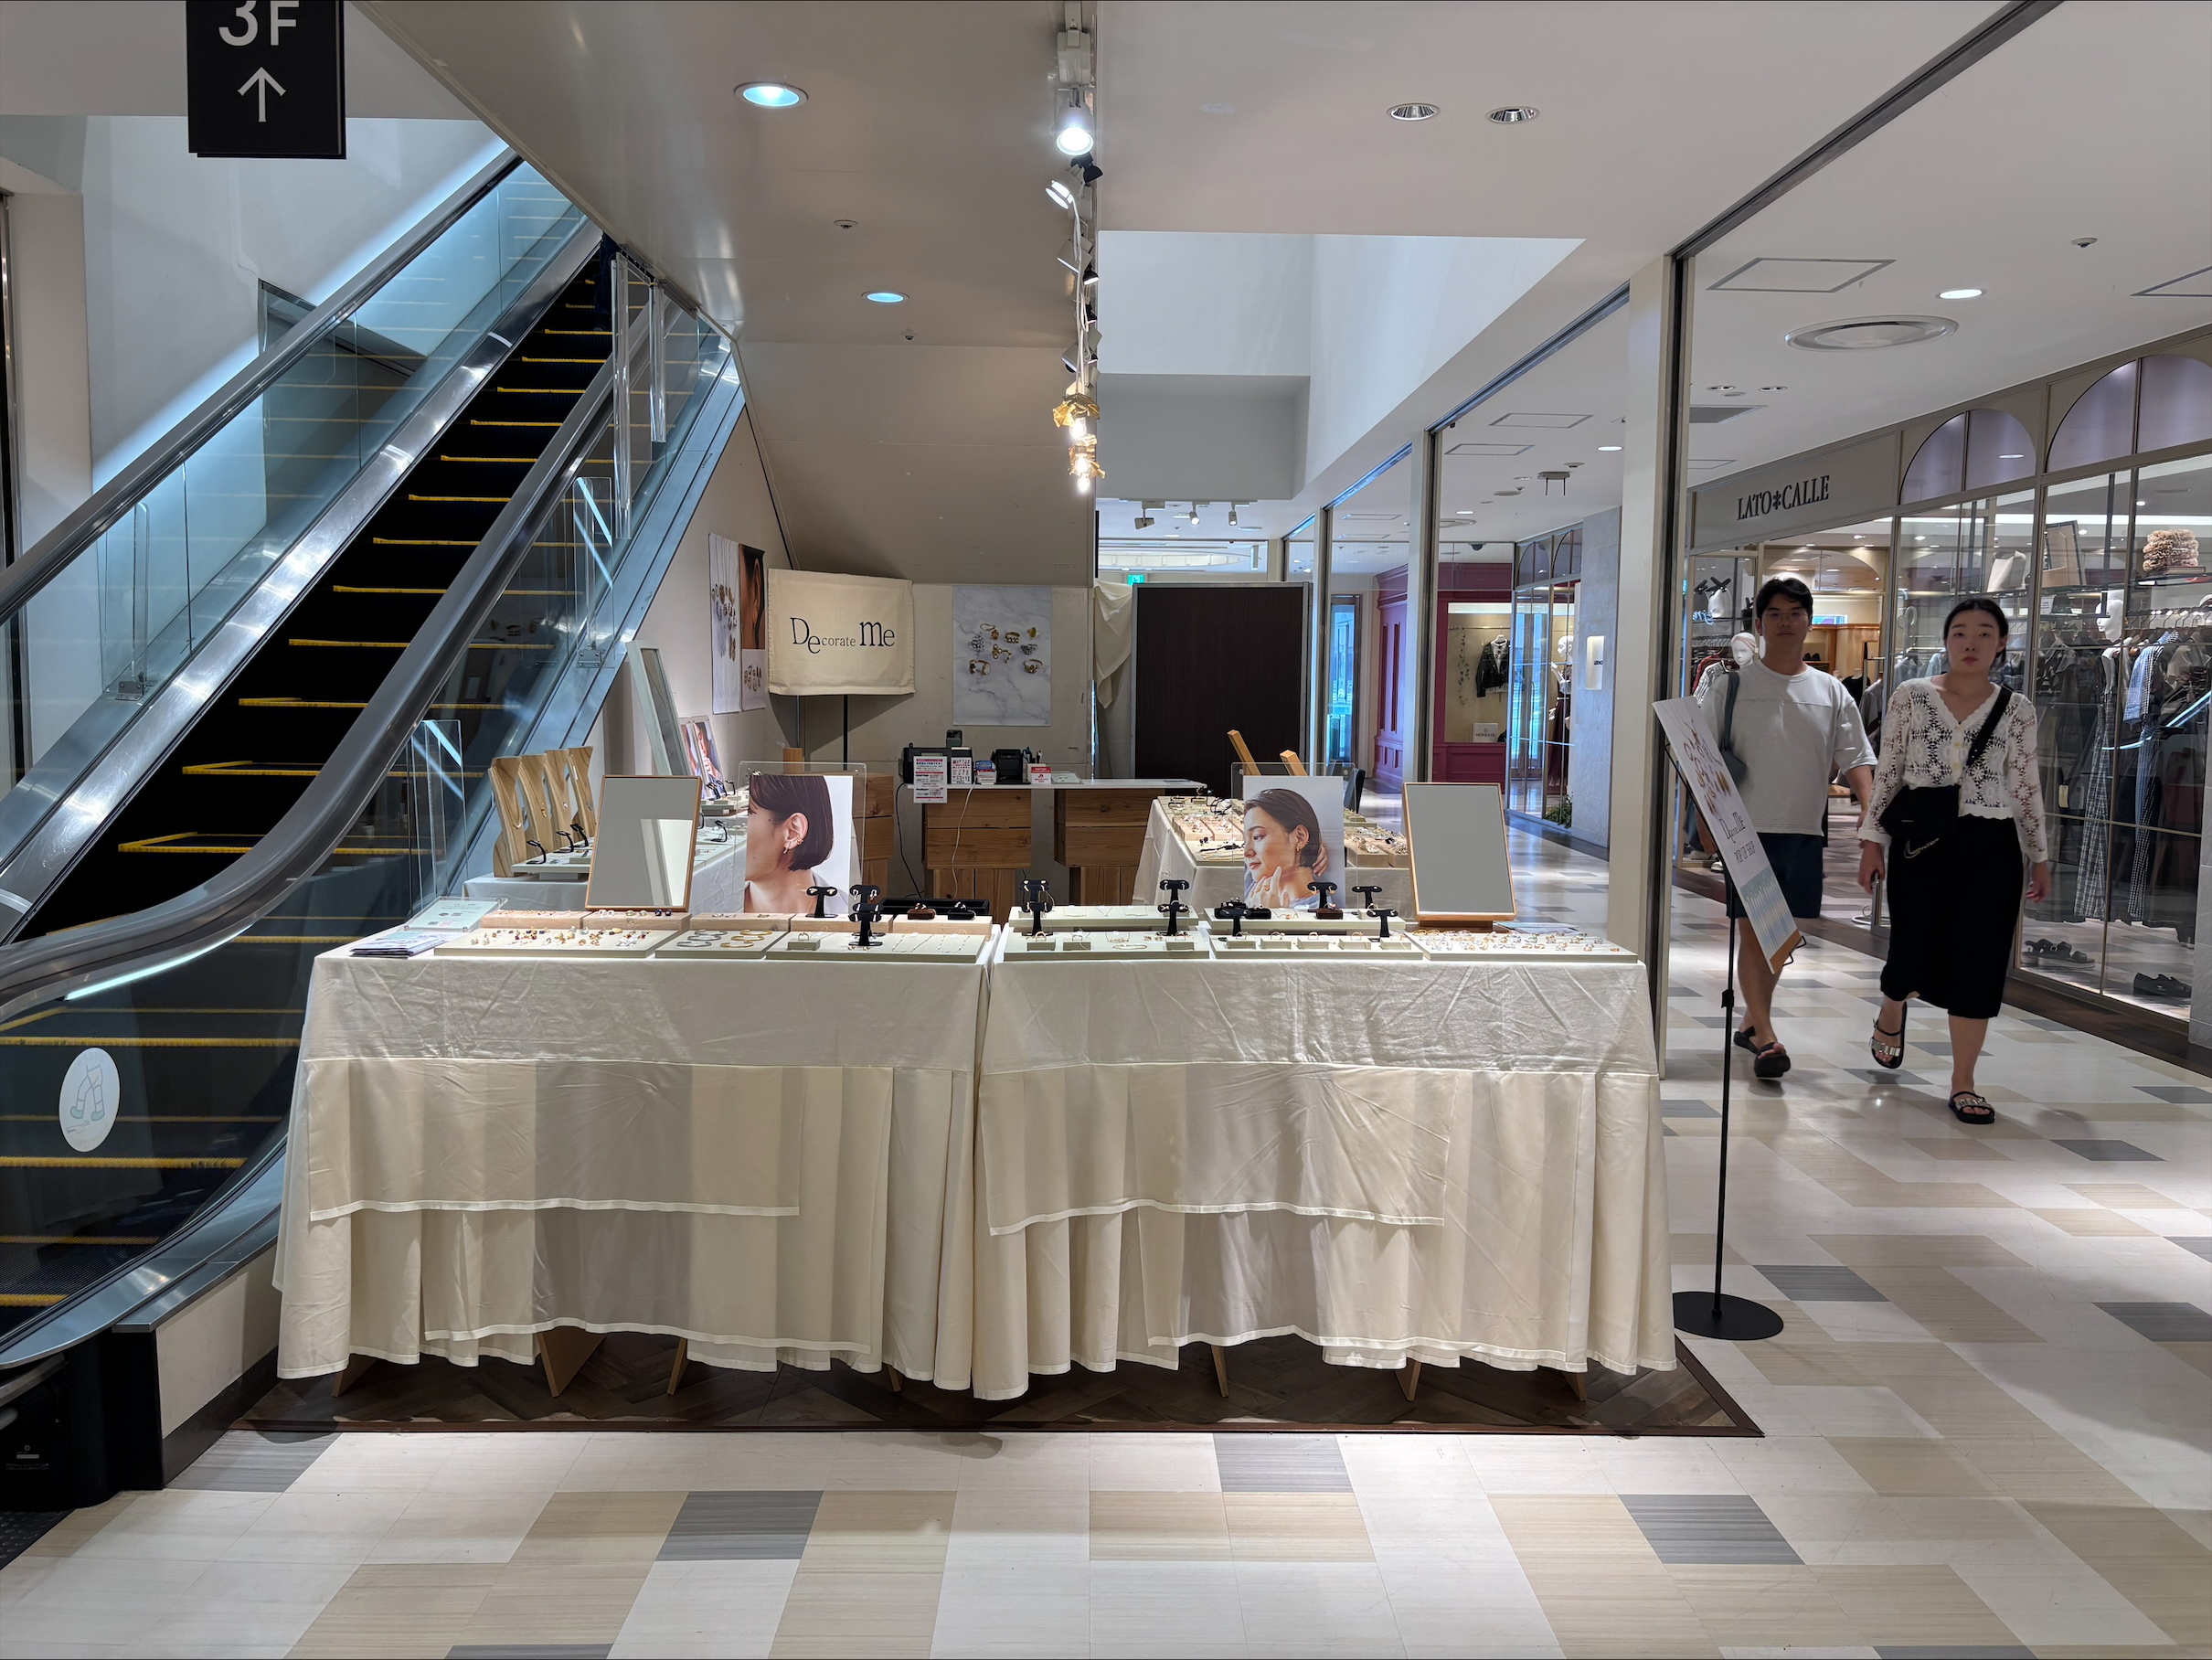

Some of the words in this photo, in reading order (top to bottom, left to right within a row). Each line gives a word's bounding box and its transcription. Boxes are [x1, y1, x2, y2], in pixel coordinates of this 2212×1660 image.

[218, 0, 300, 47] 3F
[1737, 490, 1772, 521] LATO
[1781, 474, 1830, 510] CALLE
[790, 617, 856, 654] Decorate
